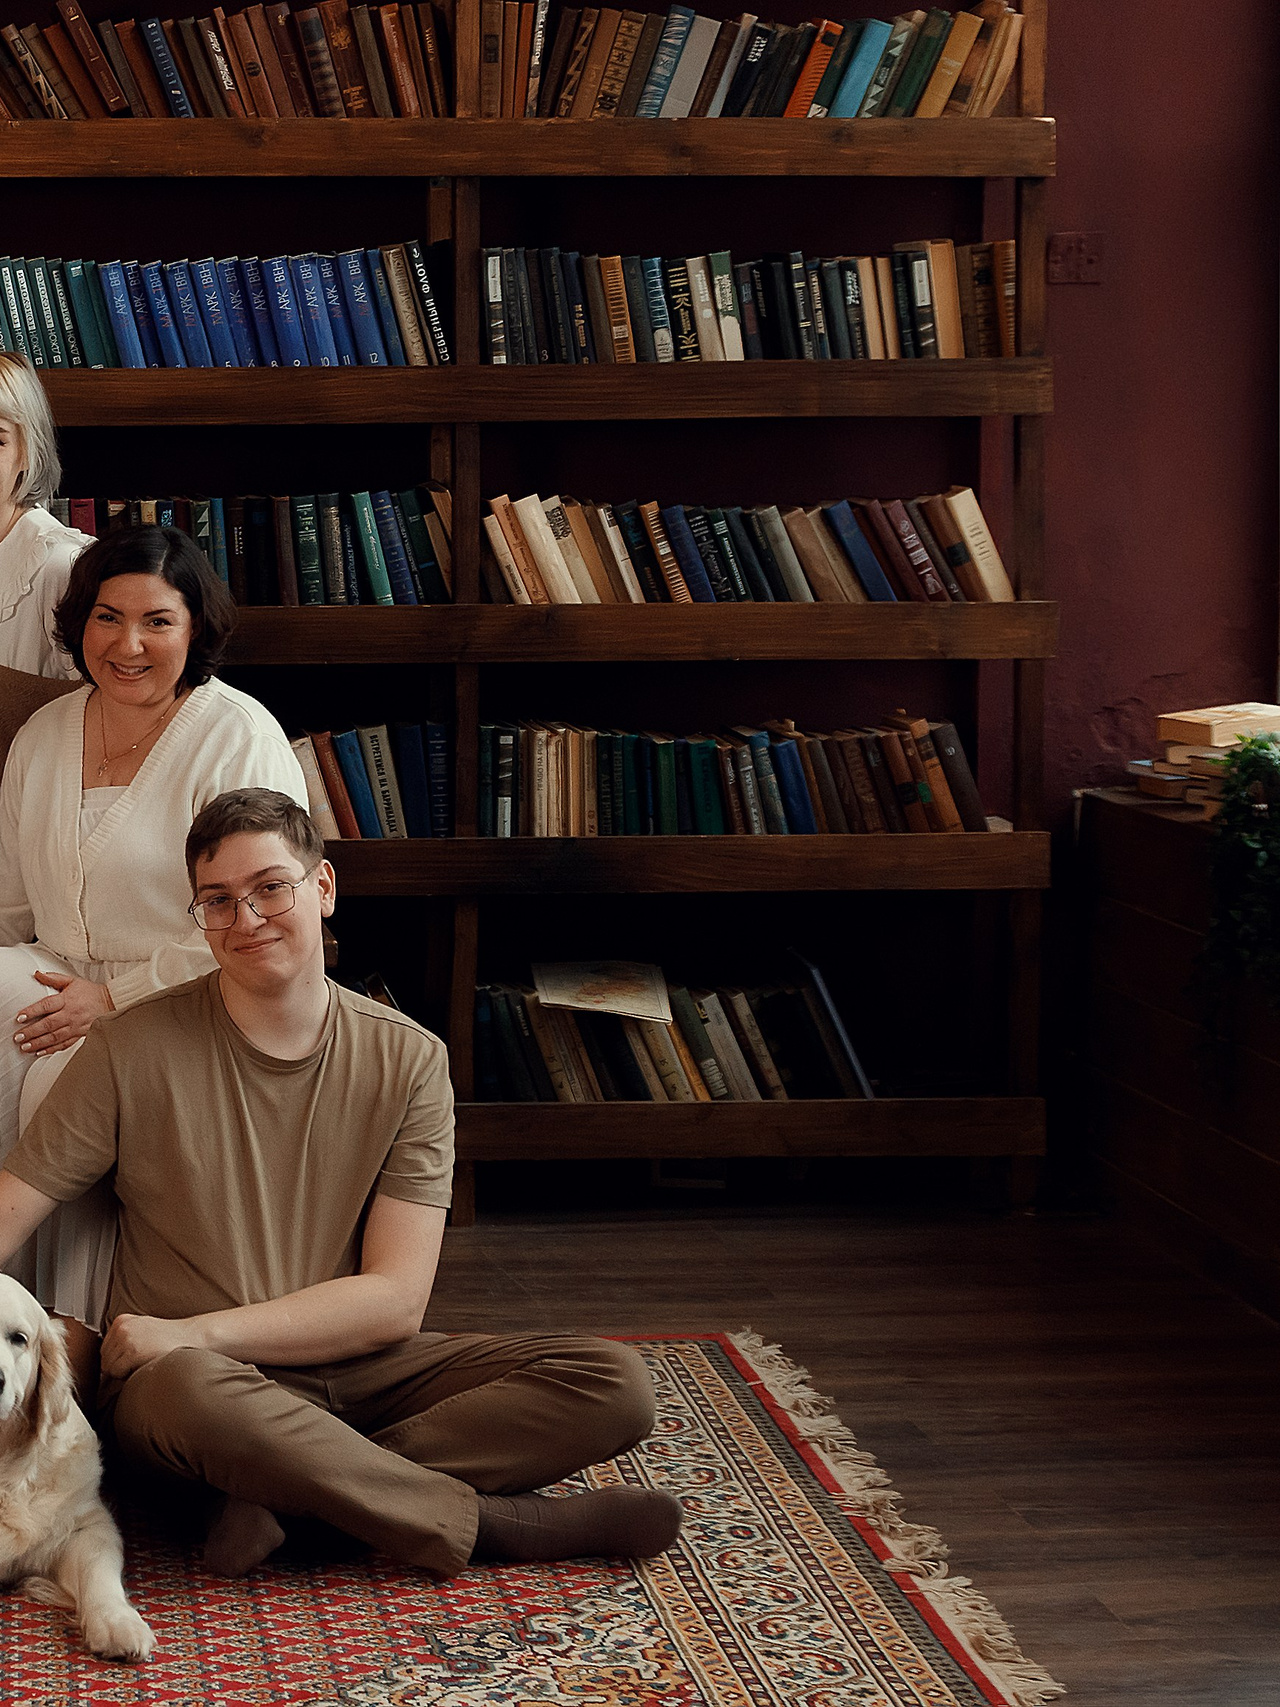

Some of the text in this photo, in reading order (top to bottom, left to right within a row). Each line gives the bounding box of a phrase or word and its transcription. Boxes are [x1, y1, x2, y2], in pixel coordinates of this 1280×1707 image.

[198, 262, 214, 289] ТВЕН
[271, 259, 287, 289] ТВЕН
[299, 259, 313, 286] ТВЕН
[346, 253, 361, 281] ТВЕН
[2, 266, 26, 354] ДЖОН ГОЛСУОРСИ
[16, 269, 36, 330] ГОЛСУОРСИ
[35, 266, 54, 328] ГОЛСУОРСИ
[148, 265, 172, 328] МАРК ТВЕН
[173, 265, 195, 326] МАРК ТВЕН
[206, 291, 223, 325] МАРК
[277, 288, 293, 323] МАРК
[304, 286, 320, 320] МАРК
[352, 281, 367, 317] МАРК
[413, 261, 450, 361] СЕВЕРНЫЙ ФЛОТ
[30, 330, 42, 356] ДЖОН
[48, 328, 61, 354] ДЖОН
[67, 330, 79, 356] ДЖОН
[540, 349, 549, 361] 3
[369, 734, 397, 834] ВСТРЕТИМСЯ НА БАРРИКАДАХ
